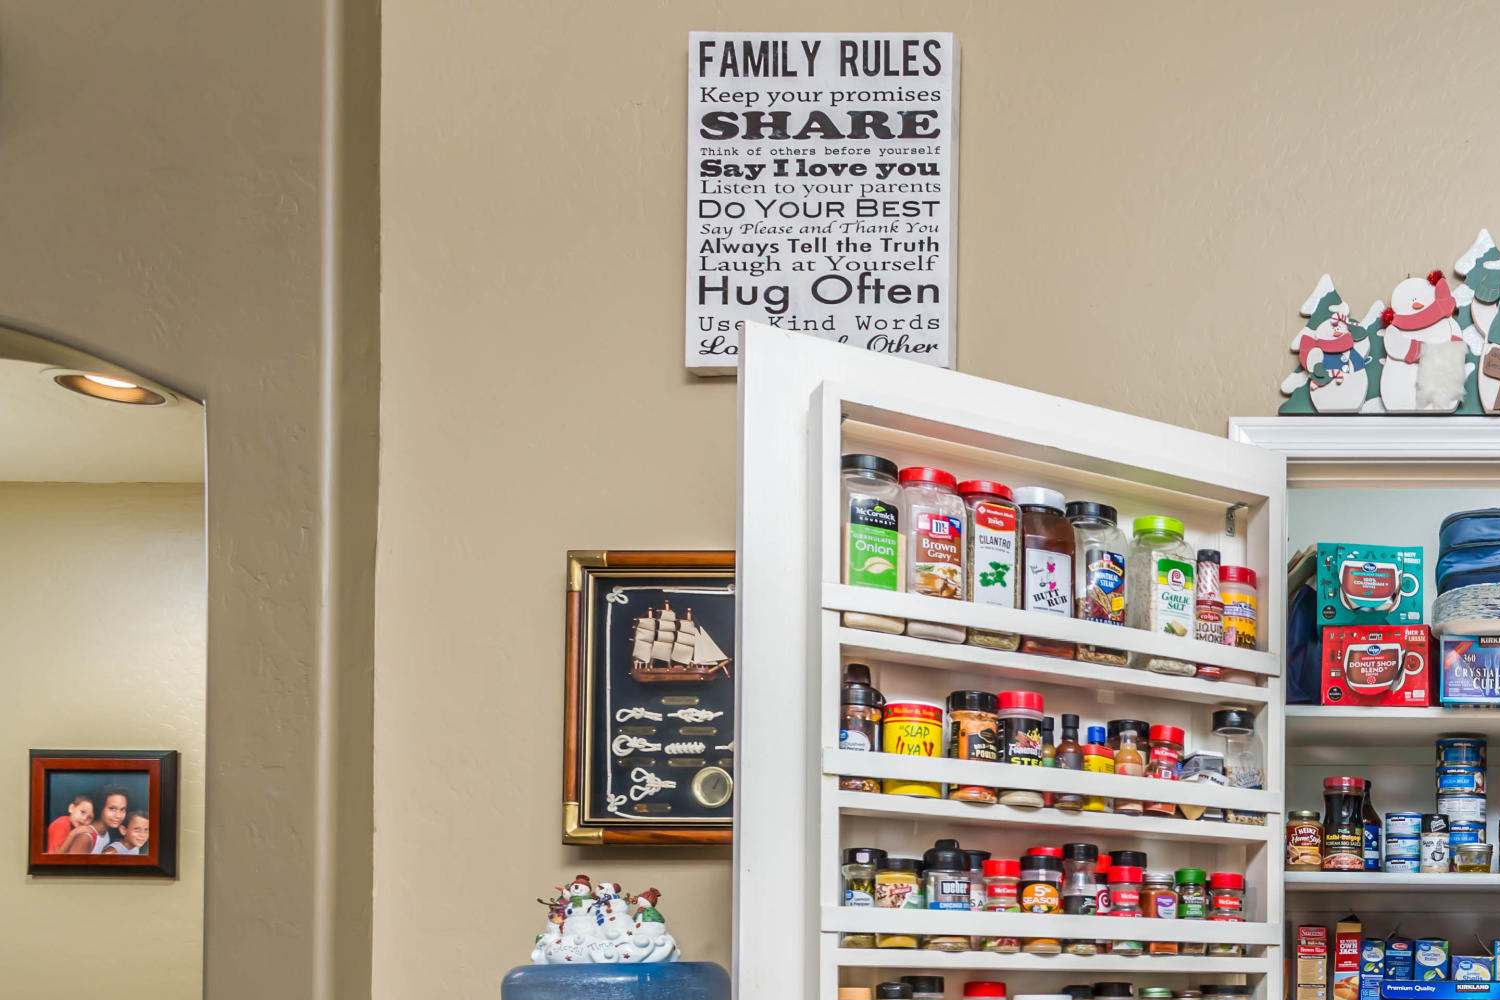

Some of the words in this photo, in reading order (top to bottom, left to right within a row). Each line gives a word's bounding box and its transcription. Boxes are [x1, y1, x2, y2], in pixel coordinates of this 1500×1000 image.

[699, 40, 821, 78] FAMILY
[839, 39, 942, 77] RULES
[700, 87, 759, 106] Keep
[767, 90, 822, 106] your
[830, 86, 941, 106] promises
[700, 109, 941, 139] SHARE
[701, 148, 739, 156] Think
[770, 147, 816, 155] others
[825, 146, 870, 155] before
[879, 146, 941, 157] yourself
[700, 159, 766, 180] Say
[773, 159, 793, 177] I
[796, 159, 867, 177] love
[876, 160, 939, 179] you
[701, 180, 765, 194] Listen
[775, 181, 794, 194] to
[802, 183, 852, 197] your
[861, 181, 941, 197] parents
[856, 199, 939, 218] BEST
[700, 223, 733, 239] Say
[739, 222, 792, 234] Please
[799, 222, 832, 234] and
[840, 221, 898, 234] Thank
[905, 222, 939, 233] You
[700, 238, 779, 254] Always
[788, 239, 826, 253] Tell
[836, 239, 871, 252] the
[880, 237, 939, 252] Truth
[699, 256, 781, 277] Laugh
[792, 259, 816, 271] at
[824, 255, 939, 271] Yourself
[699, 276, 789, 314] Hug
[811, 272, 939, 304] Often
[699, 316, 745, 331] Use
[769, 316, 836, 331] Kind
[856, 315, 939, 330] Words
[699, 339, 738, 355] Lo
[866, 334, 938, 354] Other
[856, 506, 896, 522] McCormick
[855, 540, 894, 556] Onion
[923, 539, 956, 553] Brown
[979, 535, 1011, 549] CILANTRO
[928, 550, 951, 561] Gravy
[1033, 589, 1059, 601] BUTT
[1047, 596, 1067, 607] RUB
[1162, 592, 1190, 604] GARLIC
[1168, 602, 1185, 611] SALT
[1463, 655, 1476, 663] 360
[1455, 667, 1500, 677] CRYSTAL
[1011, 757, 1042, 767] STEA
